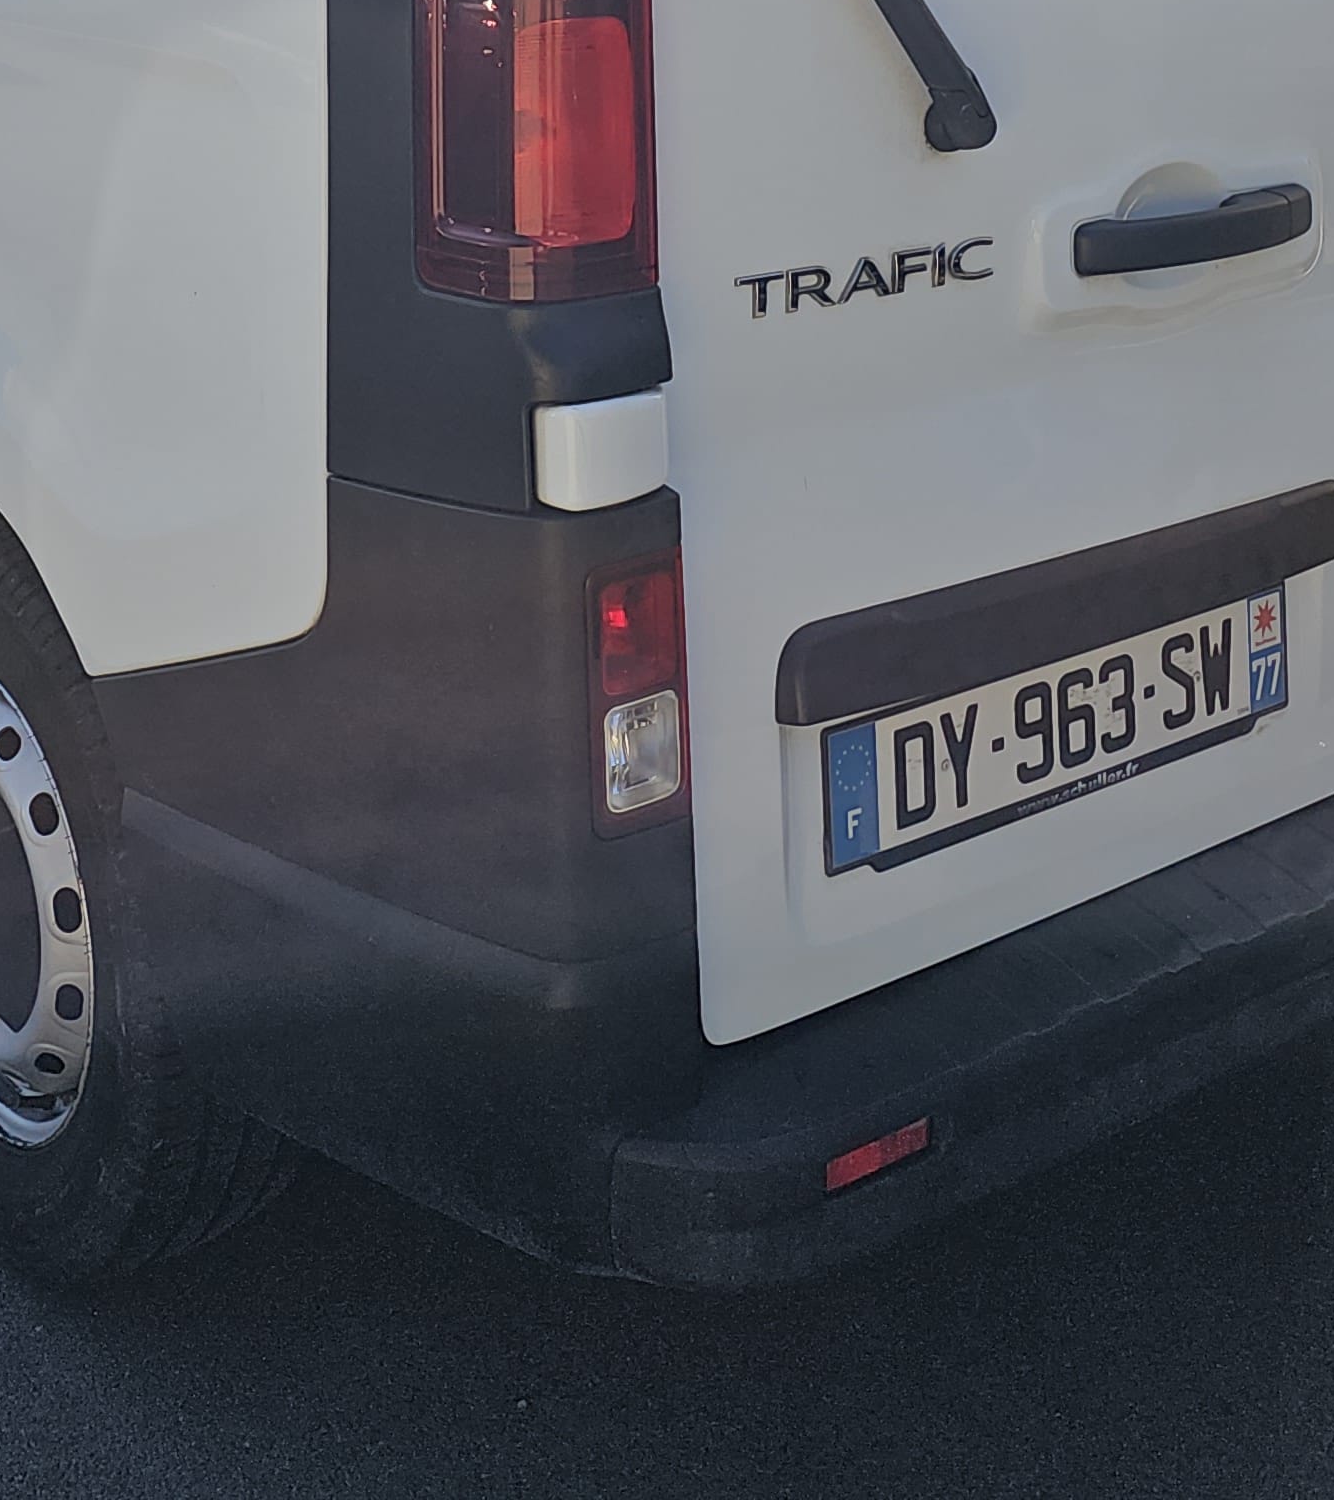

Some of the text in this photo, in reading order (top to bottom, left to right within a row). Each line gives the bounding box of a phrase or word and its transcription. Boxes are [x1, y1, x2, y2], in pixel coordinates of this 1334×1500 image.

[734, 236, 994, 319] TRAFIC
[1252, 651, 1282, 701] 77
[847, 807, 863, 840] F
